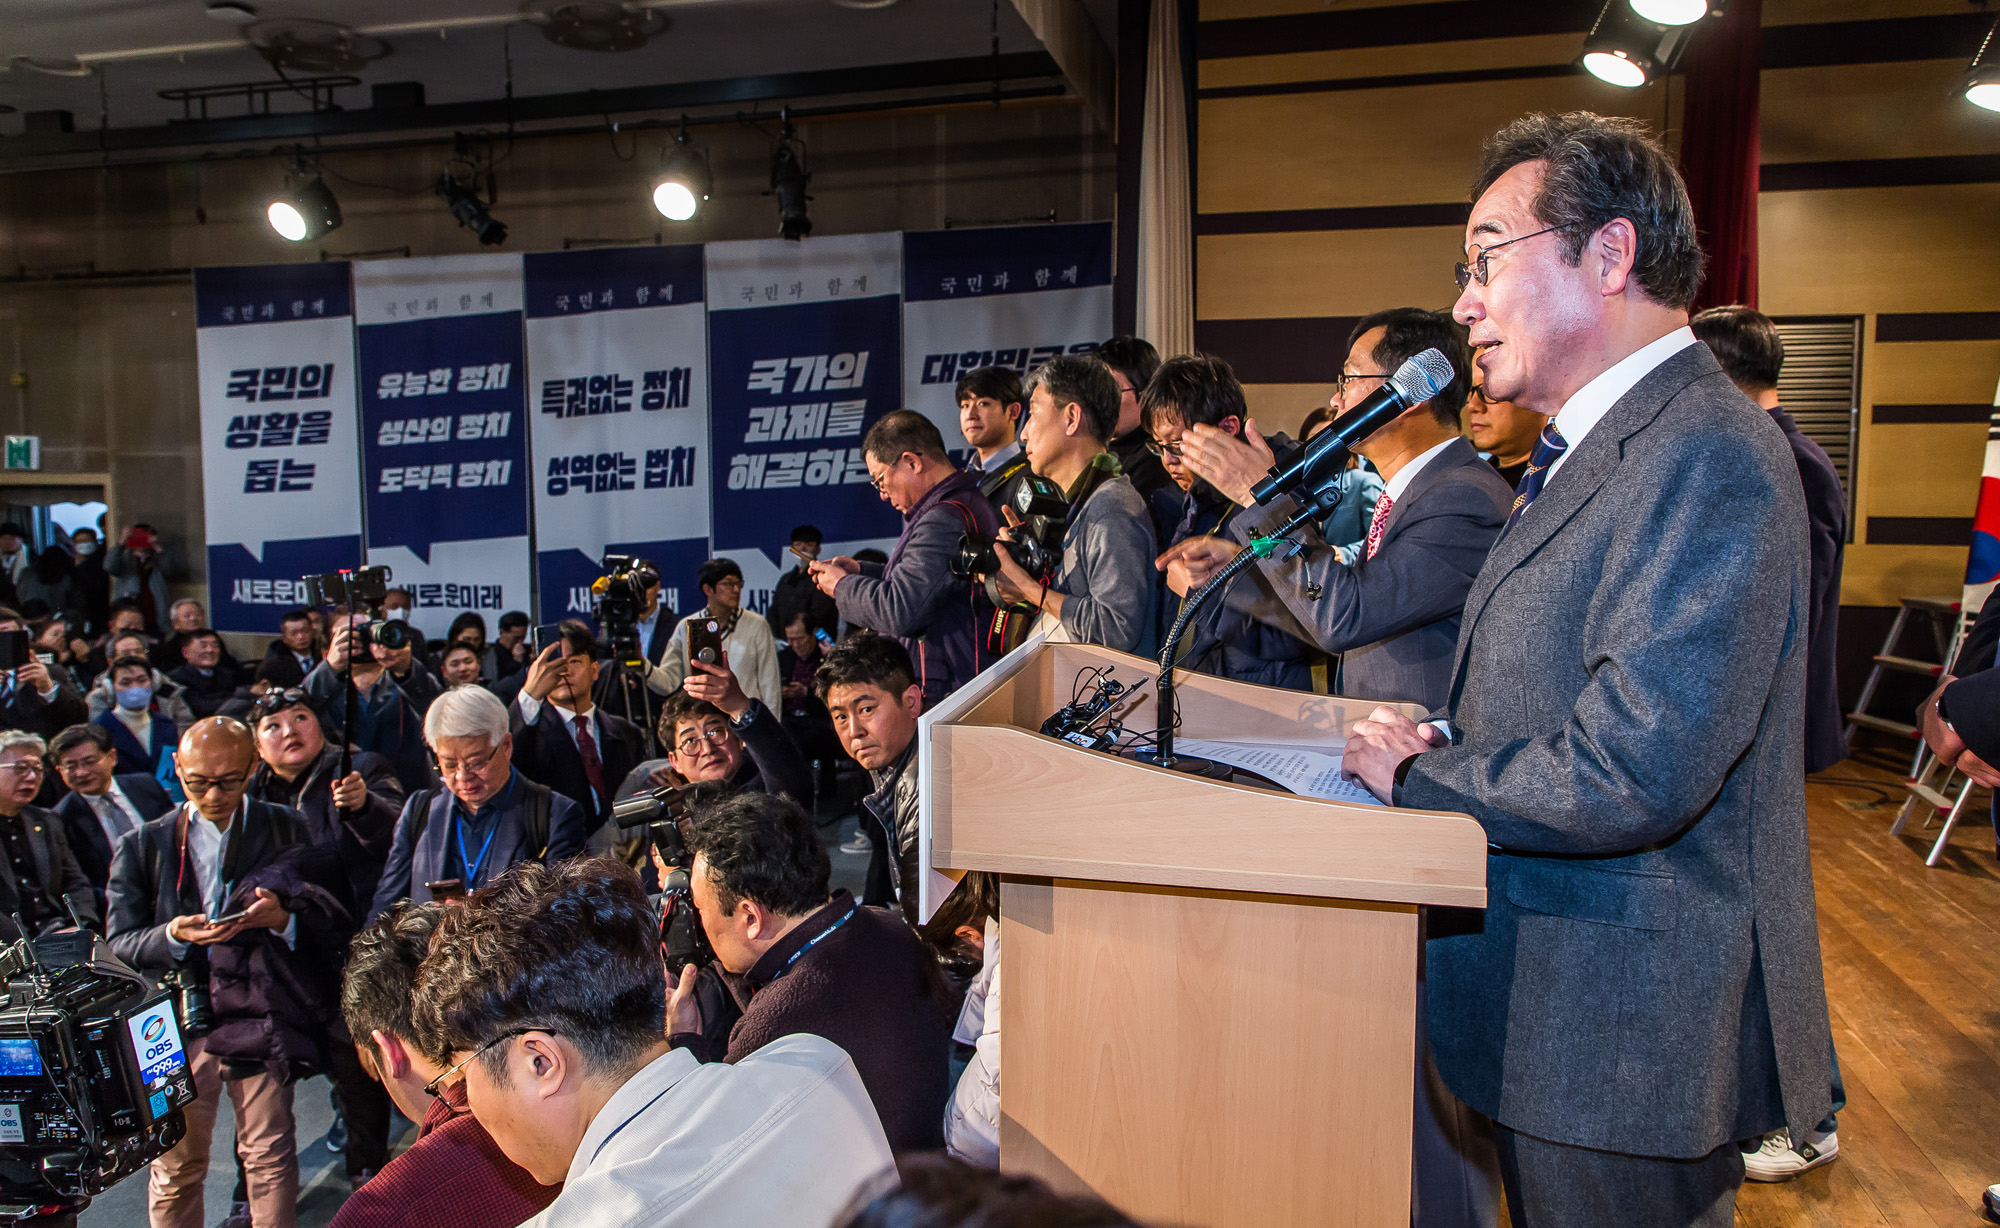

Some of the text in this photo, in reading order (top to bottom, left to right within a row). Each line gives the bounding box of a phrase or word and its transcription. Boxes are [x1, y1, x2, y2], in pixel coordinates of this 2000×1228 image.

[741, 275, 867, 303] 국민과 함께
[941, 265, 1078, 294] 국민과 함께
[221, 297, 325, 322] 국민과 함께
[385, 290, 494, 317] 국민과 함께
[556, 284, 673, 312] 국민과 함께
[377, 362, 512, 400] 유능한 정치
[747, 351, 870, 395] 국가의
[920, 342, 1100, 385] 대한민
[225, 362, 335, 403] 국민의
[541, 366, 692, 419] 특권없는 정치
[225, 410, 334, 450] 생활을
[377, 411, 512, 446] 생산의 정치
[744, 399, 867, 444] 과제를
[243, 458, 317, 494] 돕는
[378, 459, 512, 493] 도덕적 정치
[547, 446, 696, 497] 성역없는 법치
[727, 448, 875, 491] 해결하는
[232, 578, 308, 605] 새로운미
[145, 1038, 173, 1060] OBS
[152, 1057, 173, 1076] 99.9
[0, 1119, 18, 1127] OBS
